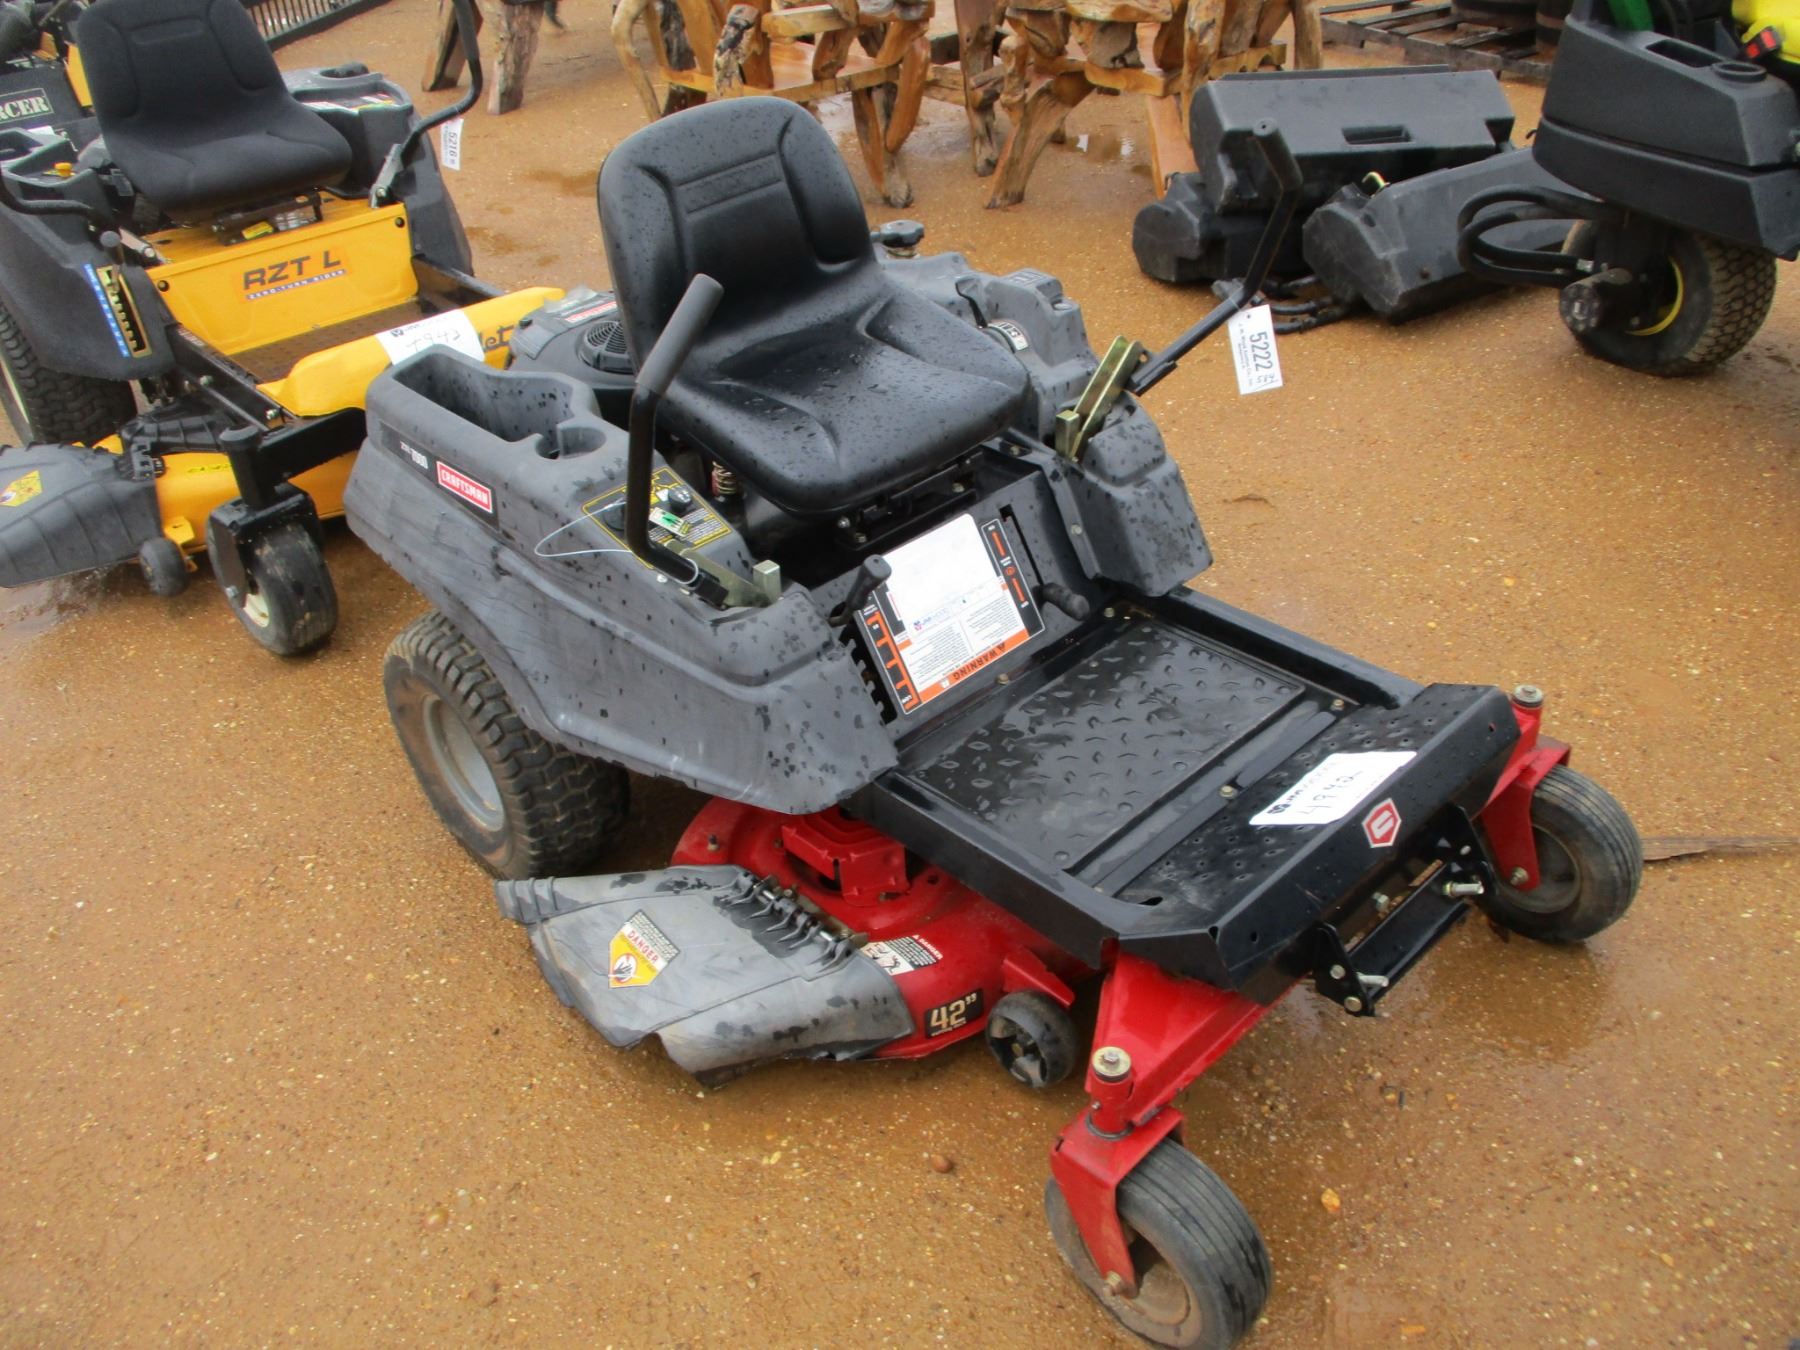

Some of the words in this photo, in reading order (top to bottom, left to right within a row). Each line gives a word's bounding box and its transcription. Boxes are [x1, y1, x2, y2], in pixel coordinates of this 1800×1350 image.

[244, 256, 310, 290] RZT
[324, 251, 341, 268] L
[1249, 331, 1274, 371] 5222
[952, 649, 998, 681] WARNING
[627, 930, 659, 963] DANGER
